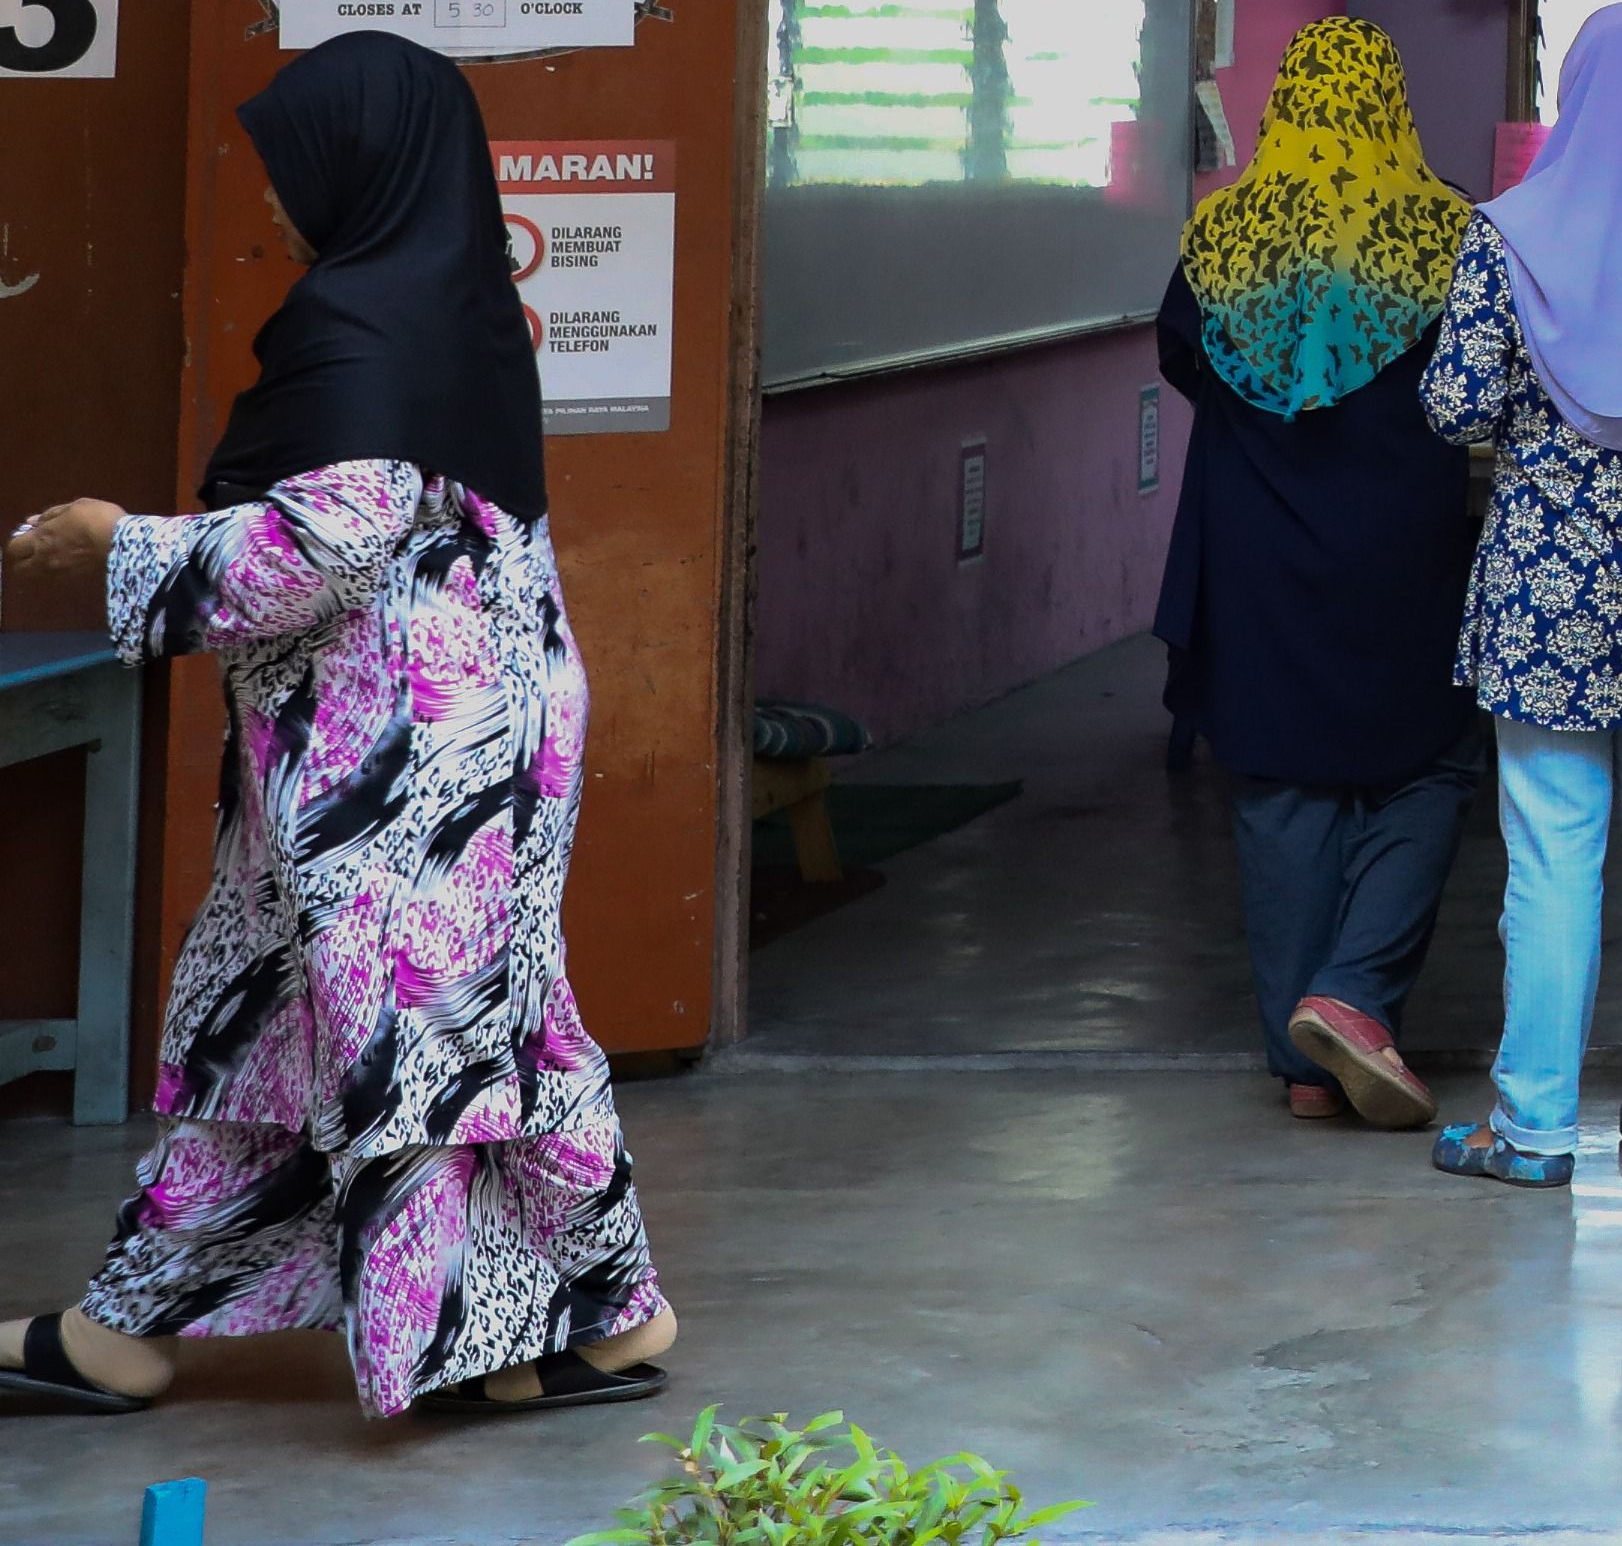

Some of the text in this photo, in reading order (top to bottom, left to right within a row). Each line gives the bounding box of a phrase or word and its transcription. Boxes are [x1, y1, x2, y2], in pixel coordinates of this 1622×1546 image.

[337, 4, 422, 16] CLOSES AT
[448, 3, 494, 18] 5 30
[521, 3, 583, 15] O'CLOCK
[495, 155, 653, 181] MARAN!
[551, 226, 622, 239] DILARANG
[551, 240, 622, 254] MEMBUAT
[551, 255, 599, 268] BISING
[550, 311, 620, 325] DILARANG
[549, 324, 657, 339] MENGGUNAKAN
[549, 339, 610, 353] TELEFON
